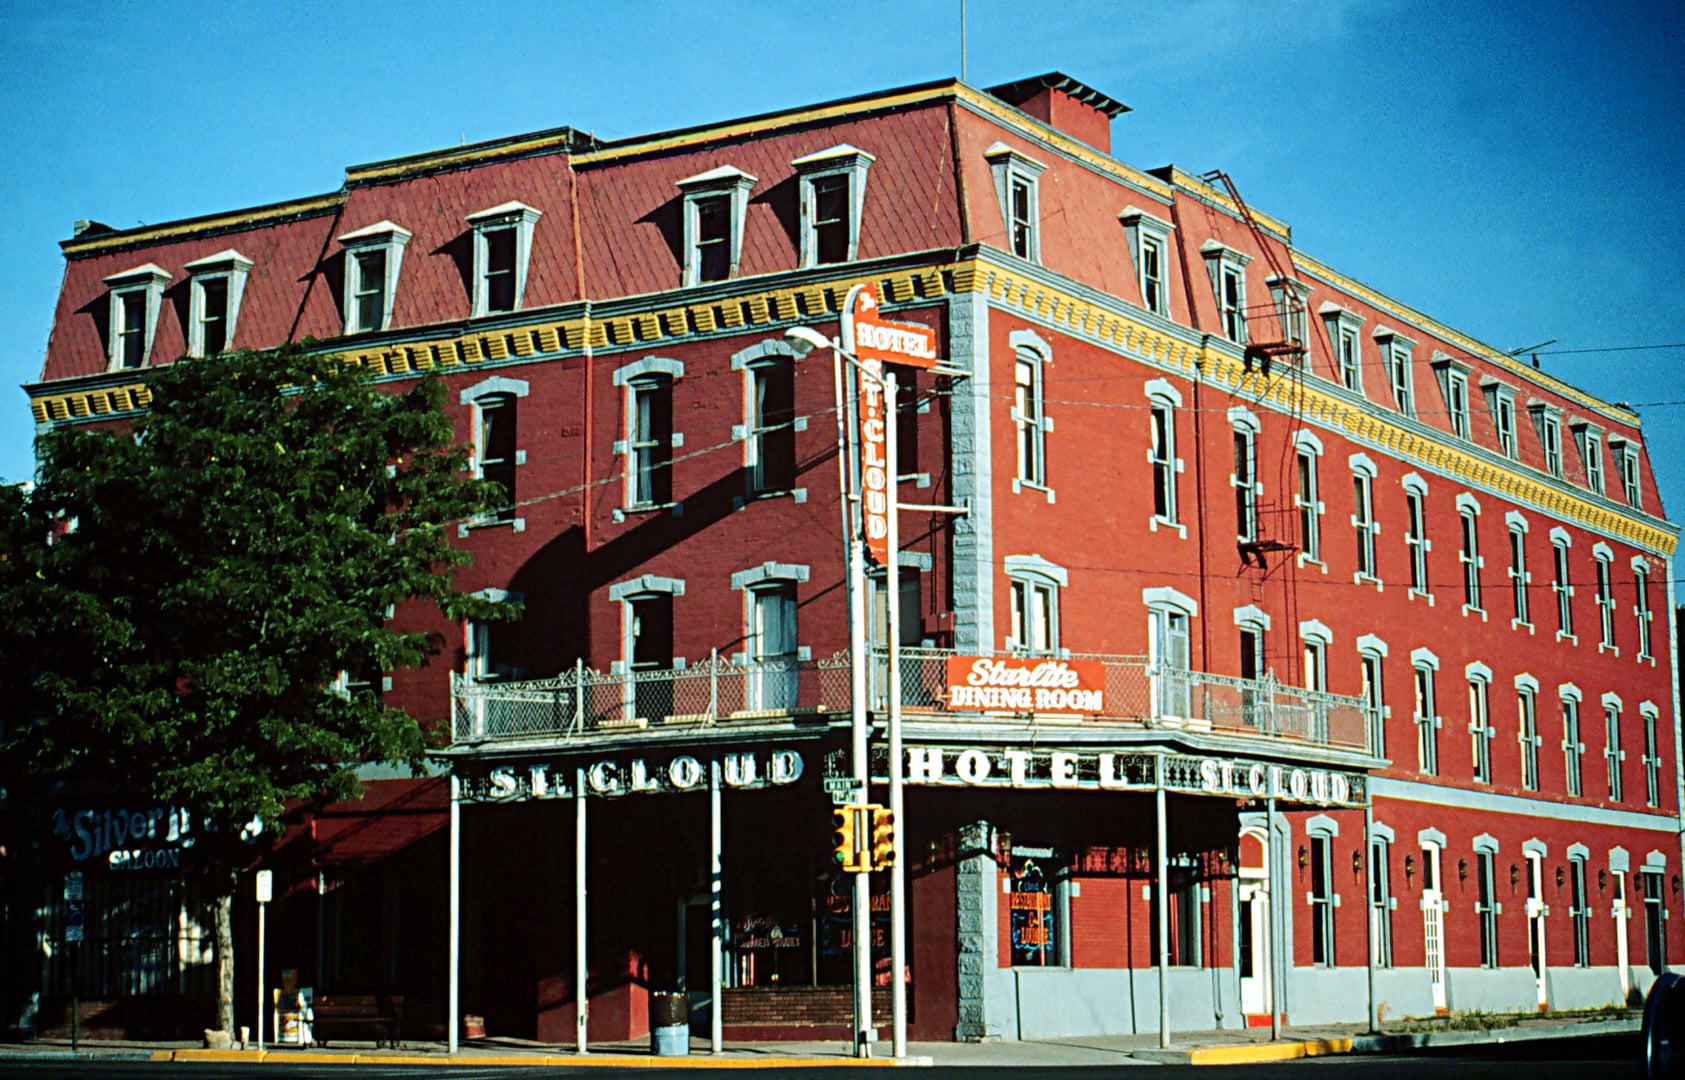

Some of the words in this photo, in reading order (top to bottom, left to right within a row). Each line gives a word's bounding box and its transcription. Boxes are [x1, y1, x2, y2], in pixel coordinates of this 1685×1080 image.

[856, 322, 936, 359] HOTEL
[863, 419, 887, 539] CLOUD
[967, 658, 1079, 688] Starlite
[950, 685, 1034, 708] DINING
[1035, 688, 1103, 711] ROOM
[588, 750, 804, 792] CLOUD
[907, 747, 1128, 789] HOTEL
[1249, 763, 1350, 803] CLOUD
[69, 807, 164, 862] Silver
[109, 848, 180, 871] SALOON
